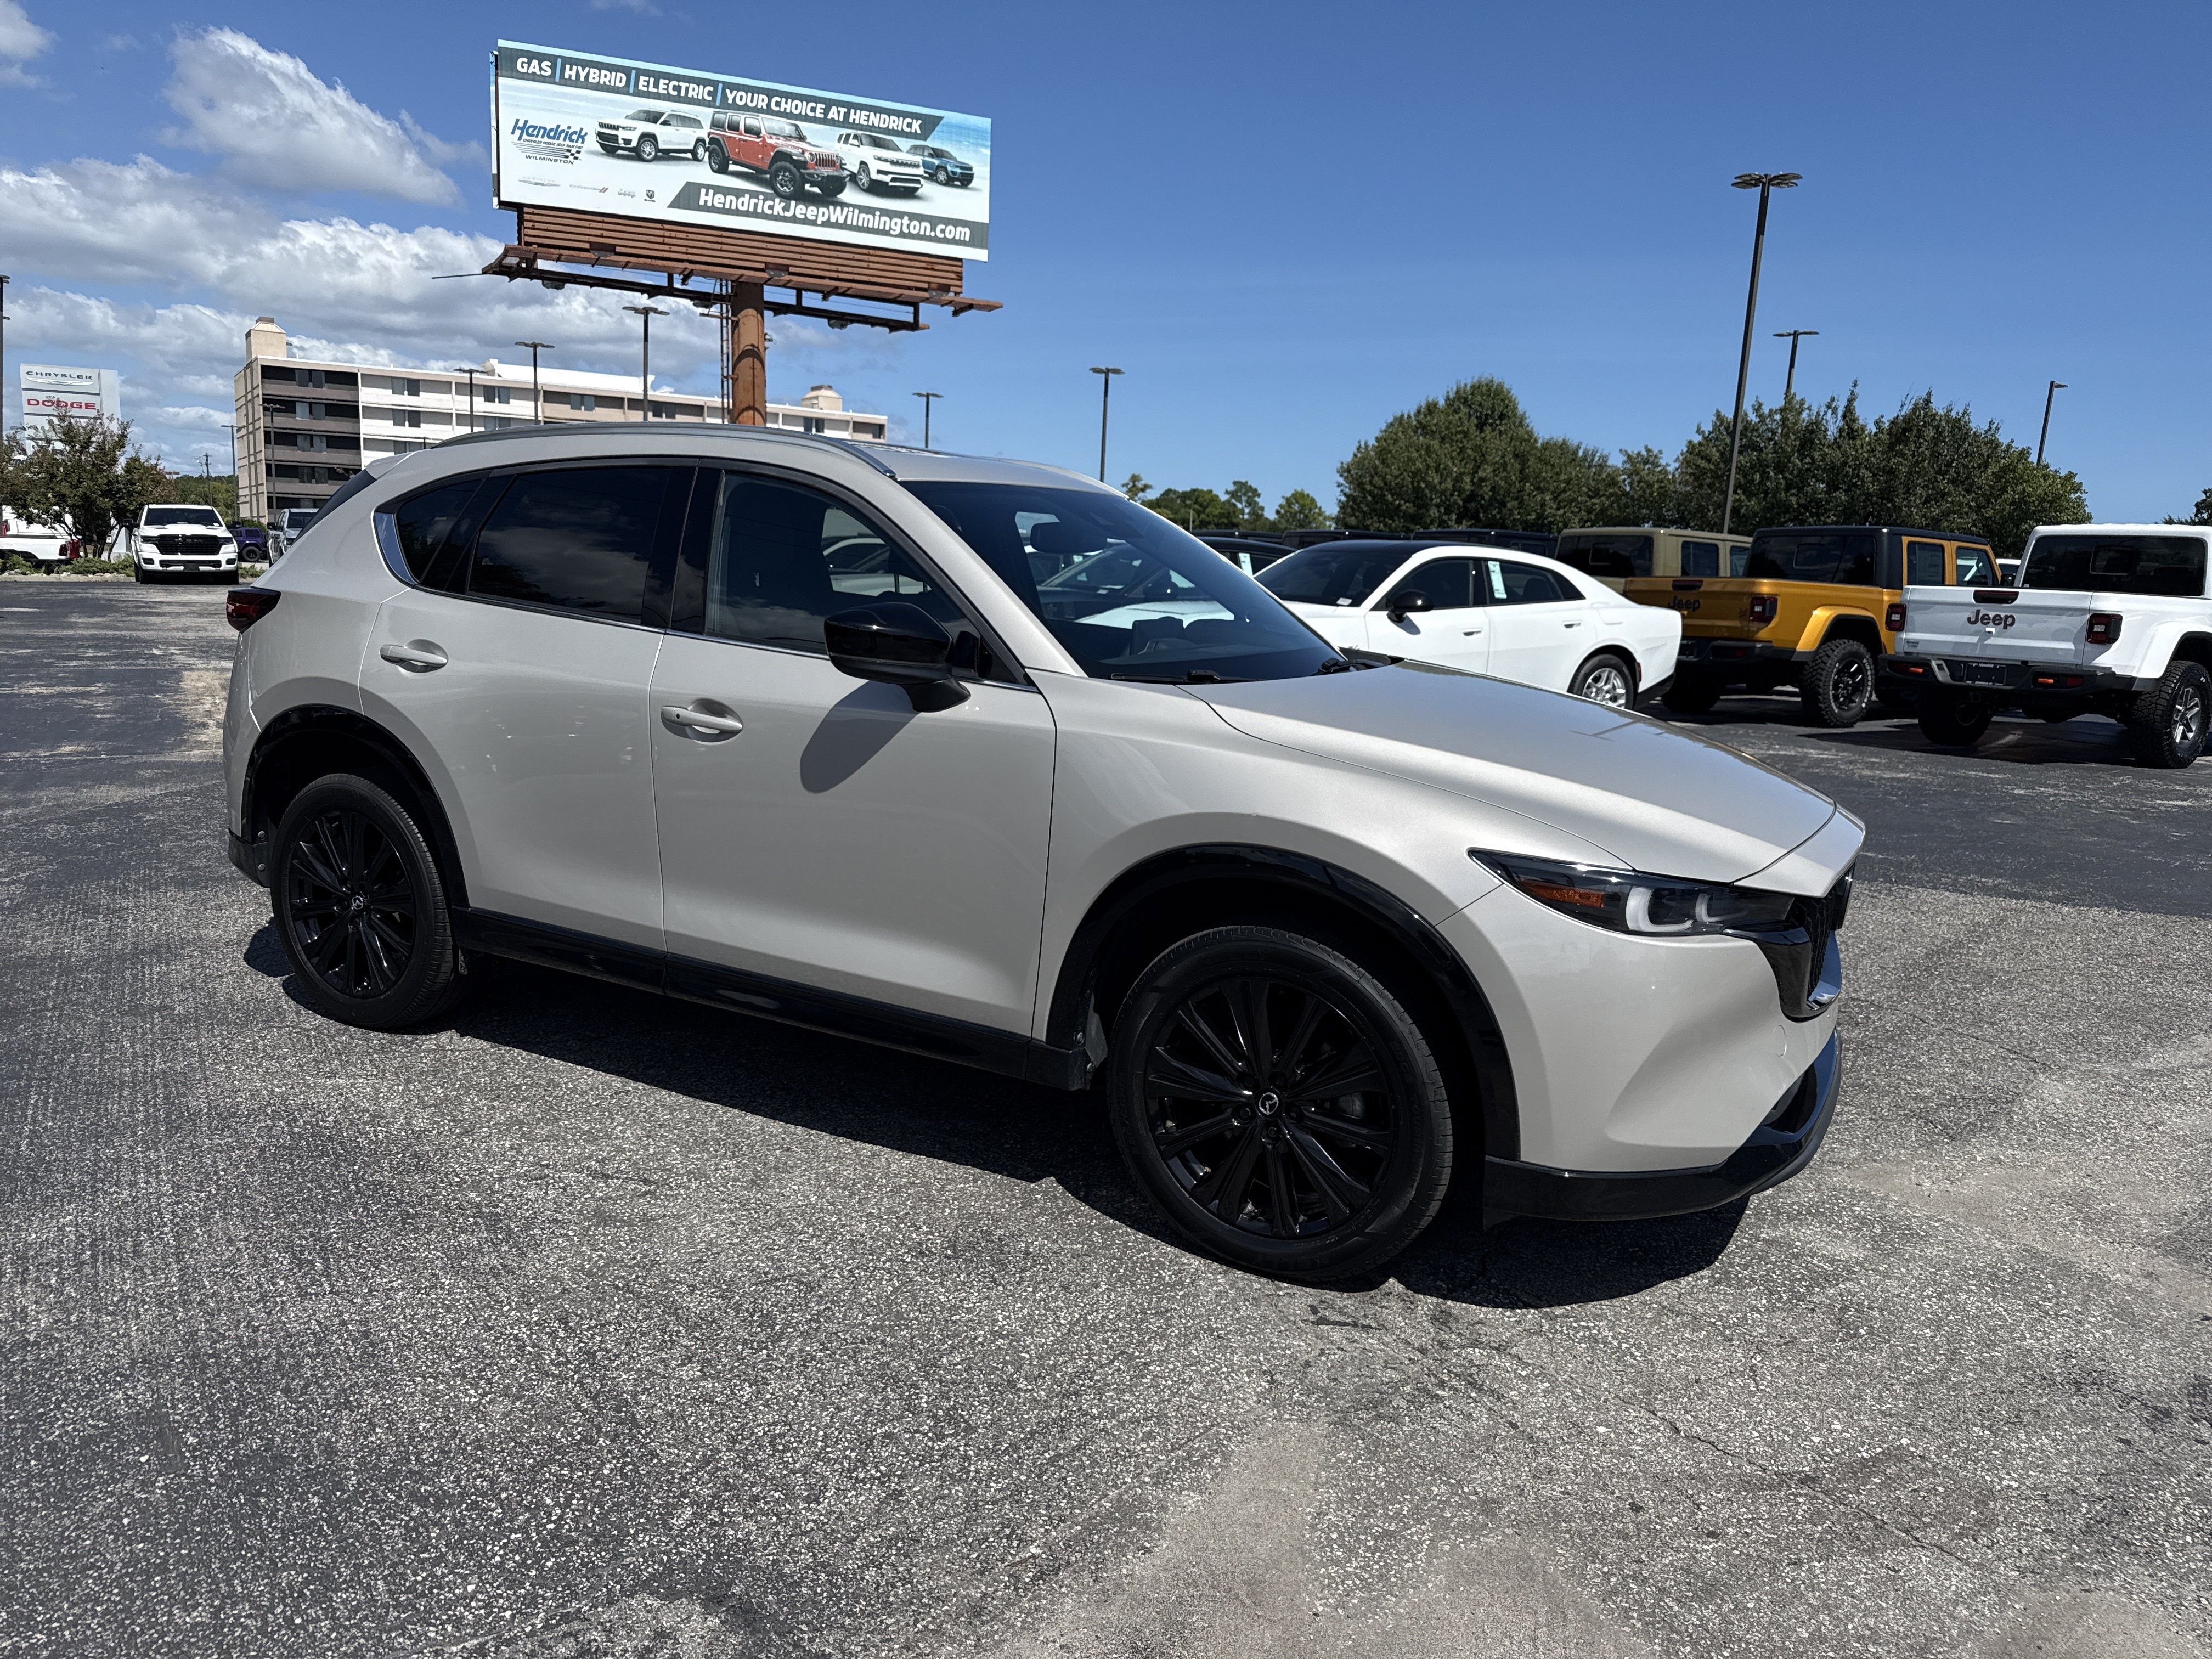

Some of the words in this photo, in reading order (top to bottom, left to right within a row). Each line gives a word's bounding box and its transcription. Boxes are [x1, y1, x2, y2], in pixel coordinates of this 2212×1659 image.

[516, 57, 552, 76] GAS
[564, 64, 627, 87] HYBRID
[638, 76, 714, 100] ELECTRIC
[726, 89, 768, 109] YOUR
[771, 97, 826, 119] CHOICE
[827, 108, 847, 121] AT
[849, 109, 922, 134] HENDRICK
[511, 119, 588, 144] Hendrick
[526, 155, 574, 165] WILMINGTON
[698, 188, 971, 241] HendrickJeepWilmington.com
[26, 371, 92, 380] CHRYSLER
[27, 398, 96, 410] DODGE
[1668, 596, 1701, 612] Jeep
[1967, 609, 2016, 629] Jeep
